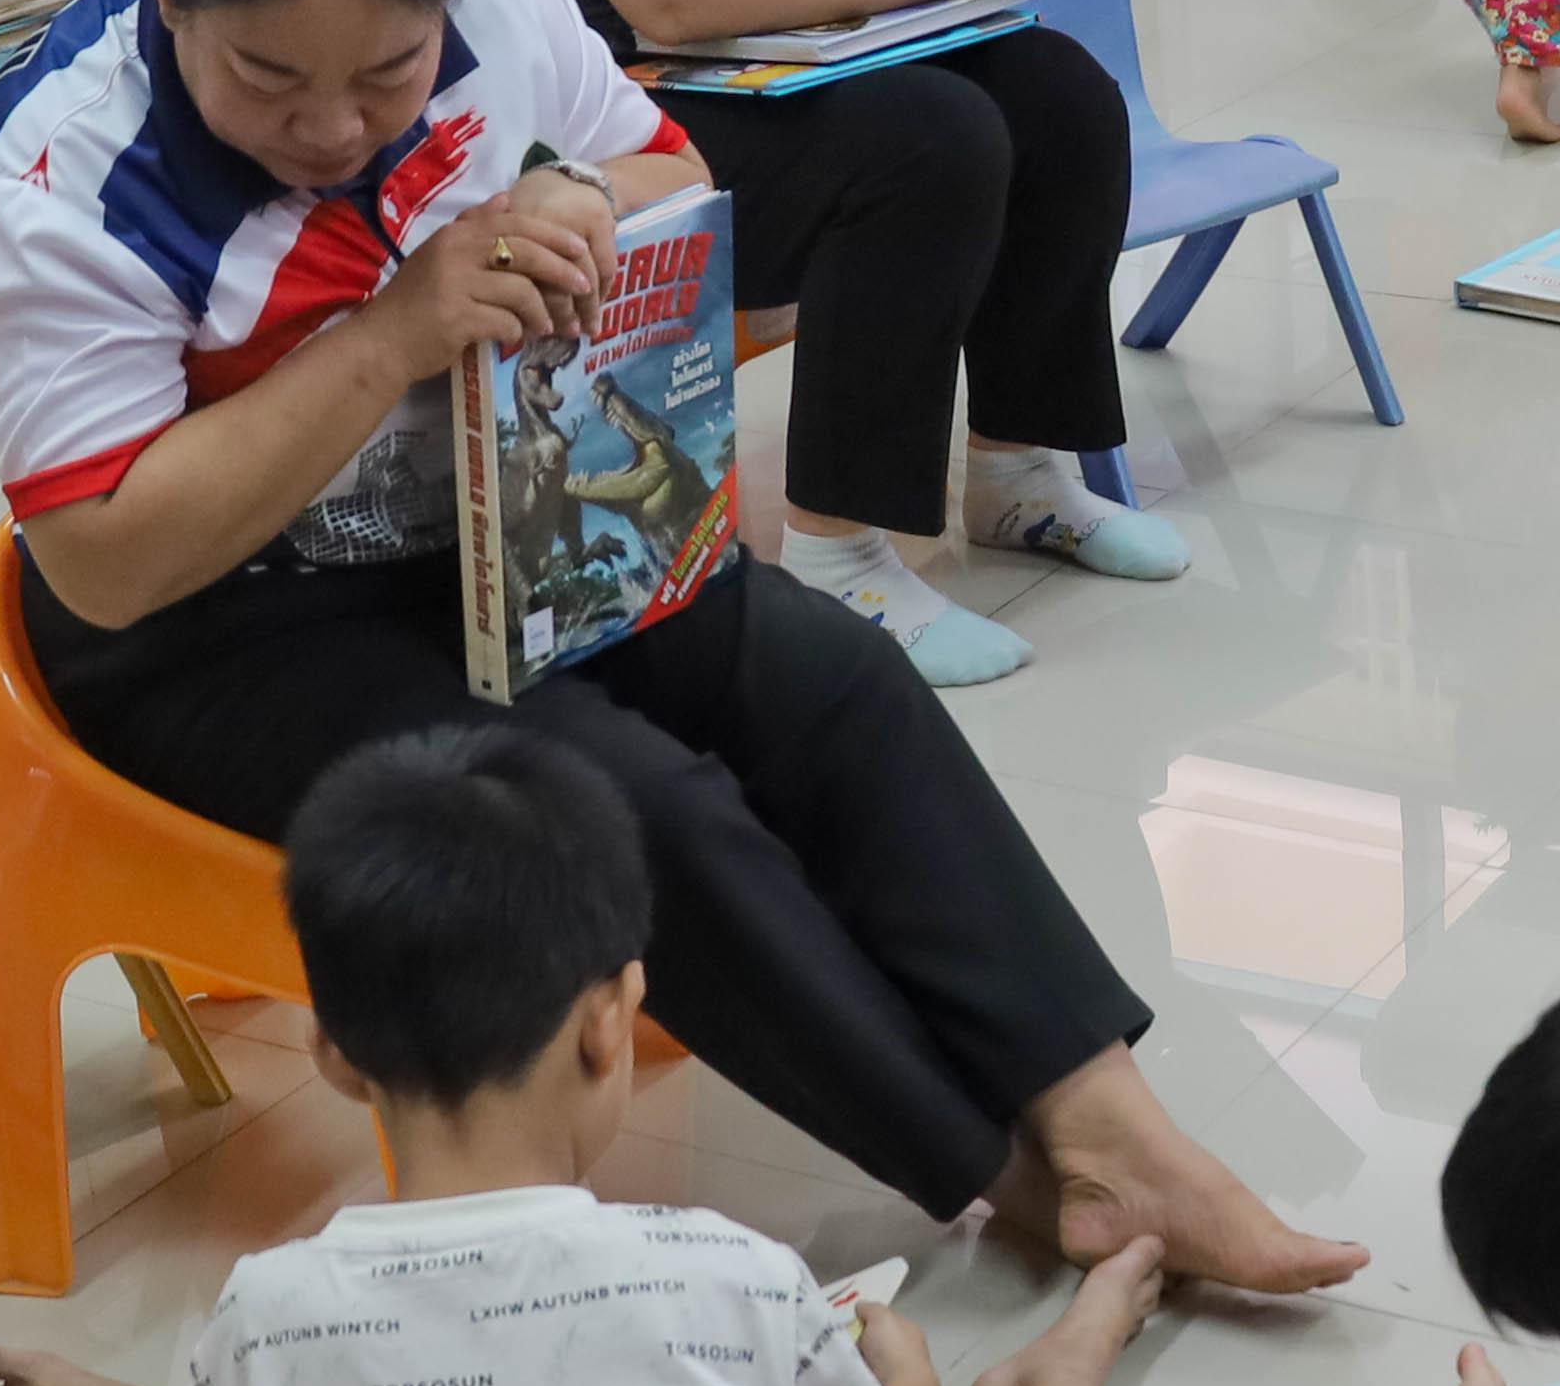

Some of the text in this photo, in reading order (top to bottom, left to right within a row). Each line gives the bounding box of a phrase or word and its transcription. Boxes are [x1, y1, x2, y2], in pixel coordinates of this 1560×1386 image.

[590, 281, 700, 346] WORLD
[371, 1249, 483, 1278] TORSOSUN
[328, 1318, 401, 1338] WINTCH
